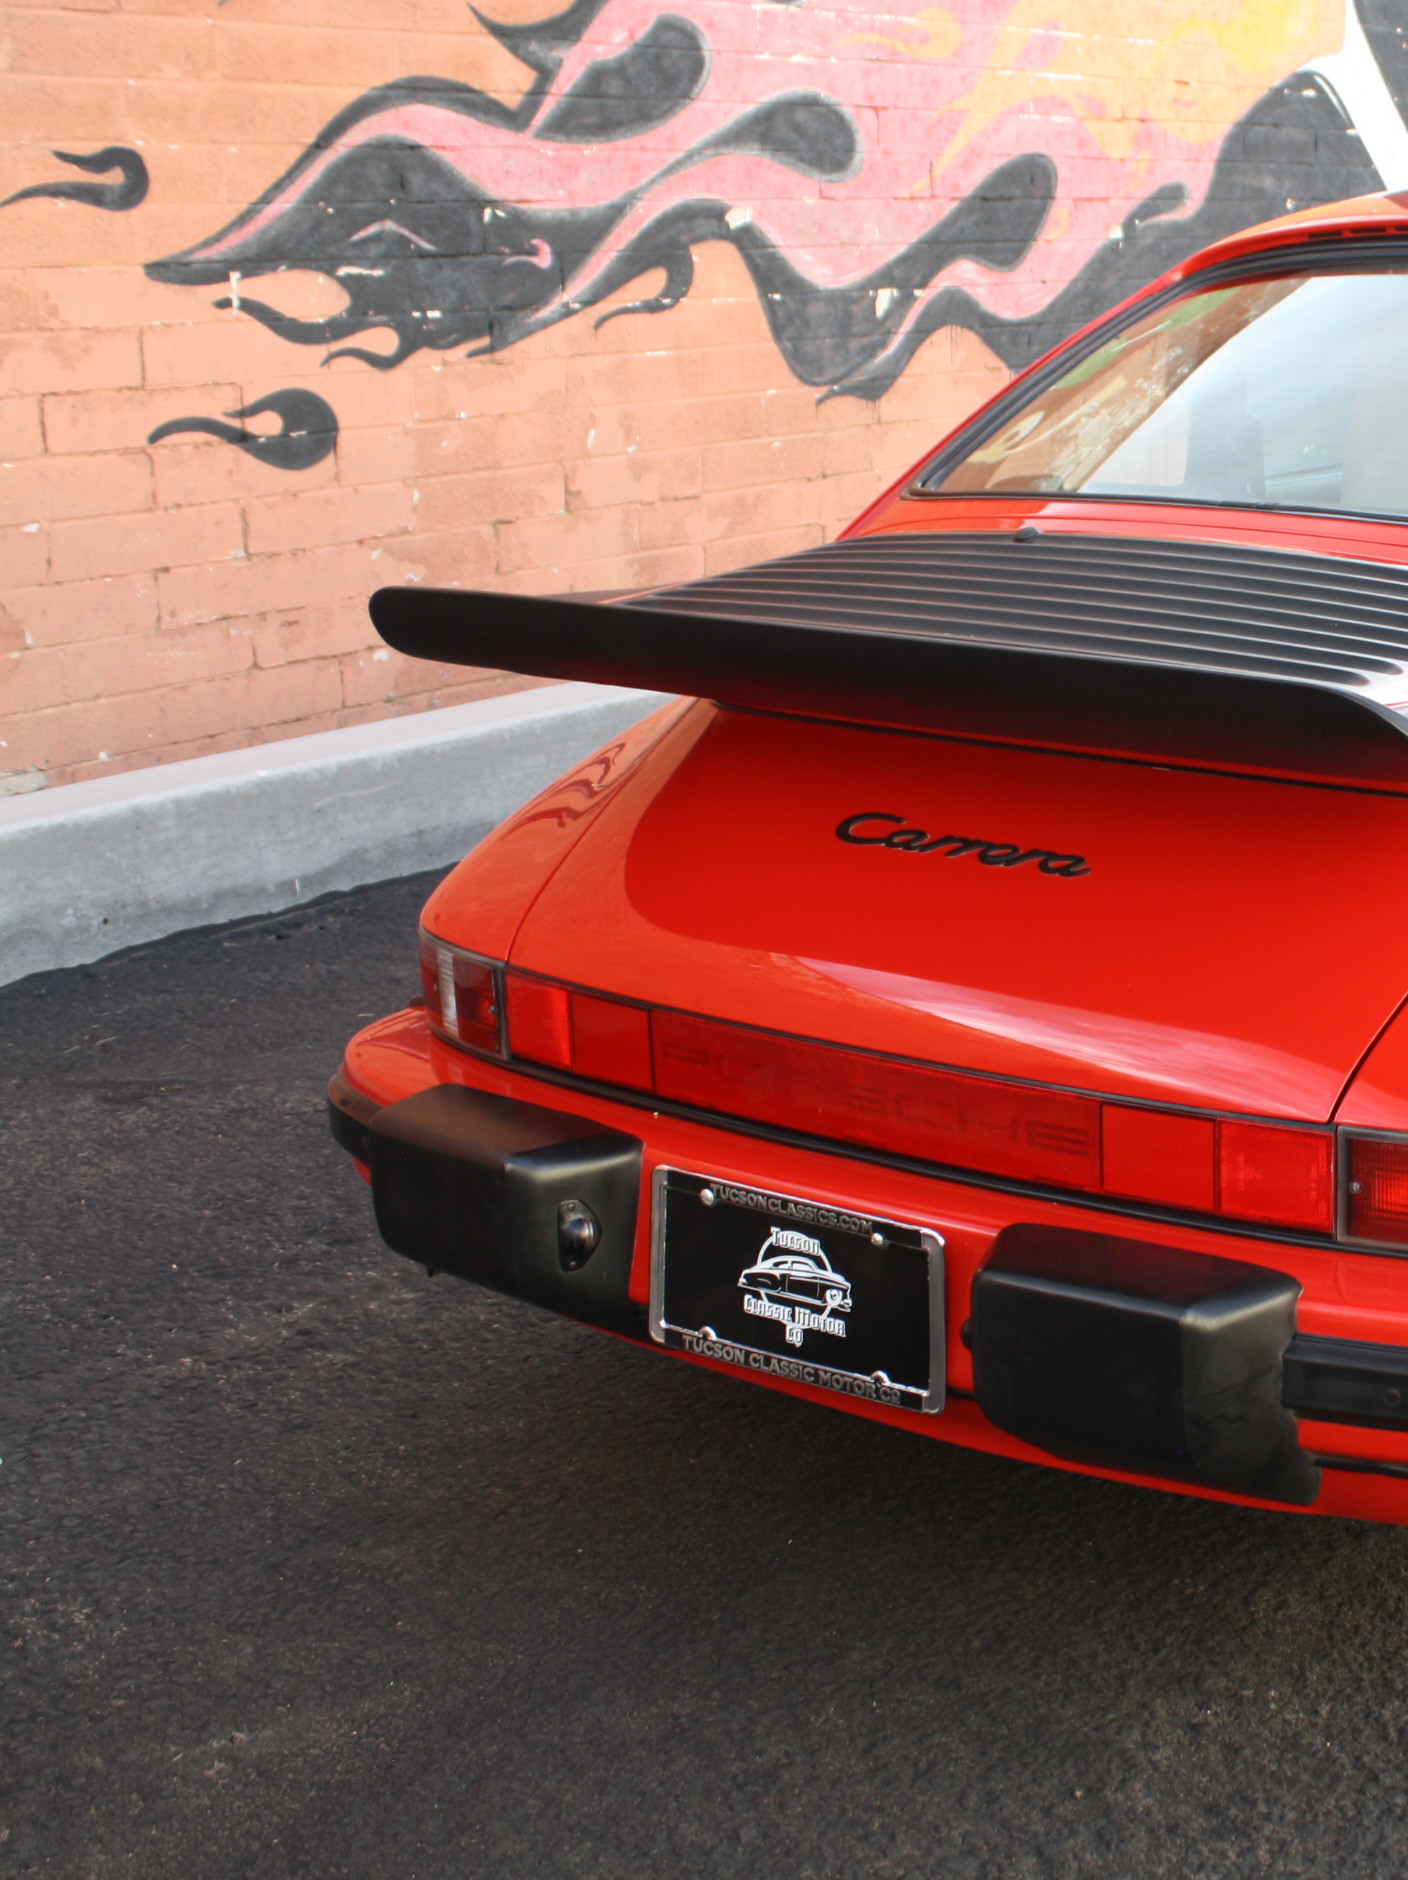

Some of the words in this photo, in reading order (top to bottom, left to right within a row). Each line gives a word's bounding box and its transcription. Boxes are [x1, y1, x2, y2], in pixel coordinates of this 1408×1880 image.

[835, 812, 1091, 877] Carrera
[709, 1182, 874, 1234] TUCSONCLASSICS.COM
[682, 1335, 745, 1365] TUCSON
[749, 1352, 815, 1383] CLASSIC
[818, 1369, 876, 1400] MOTOR
